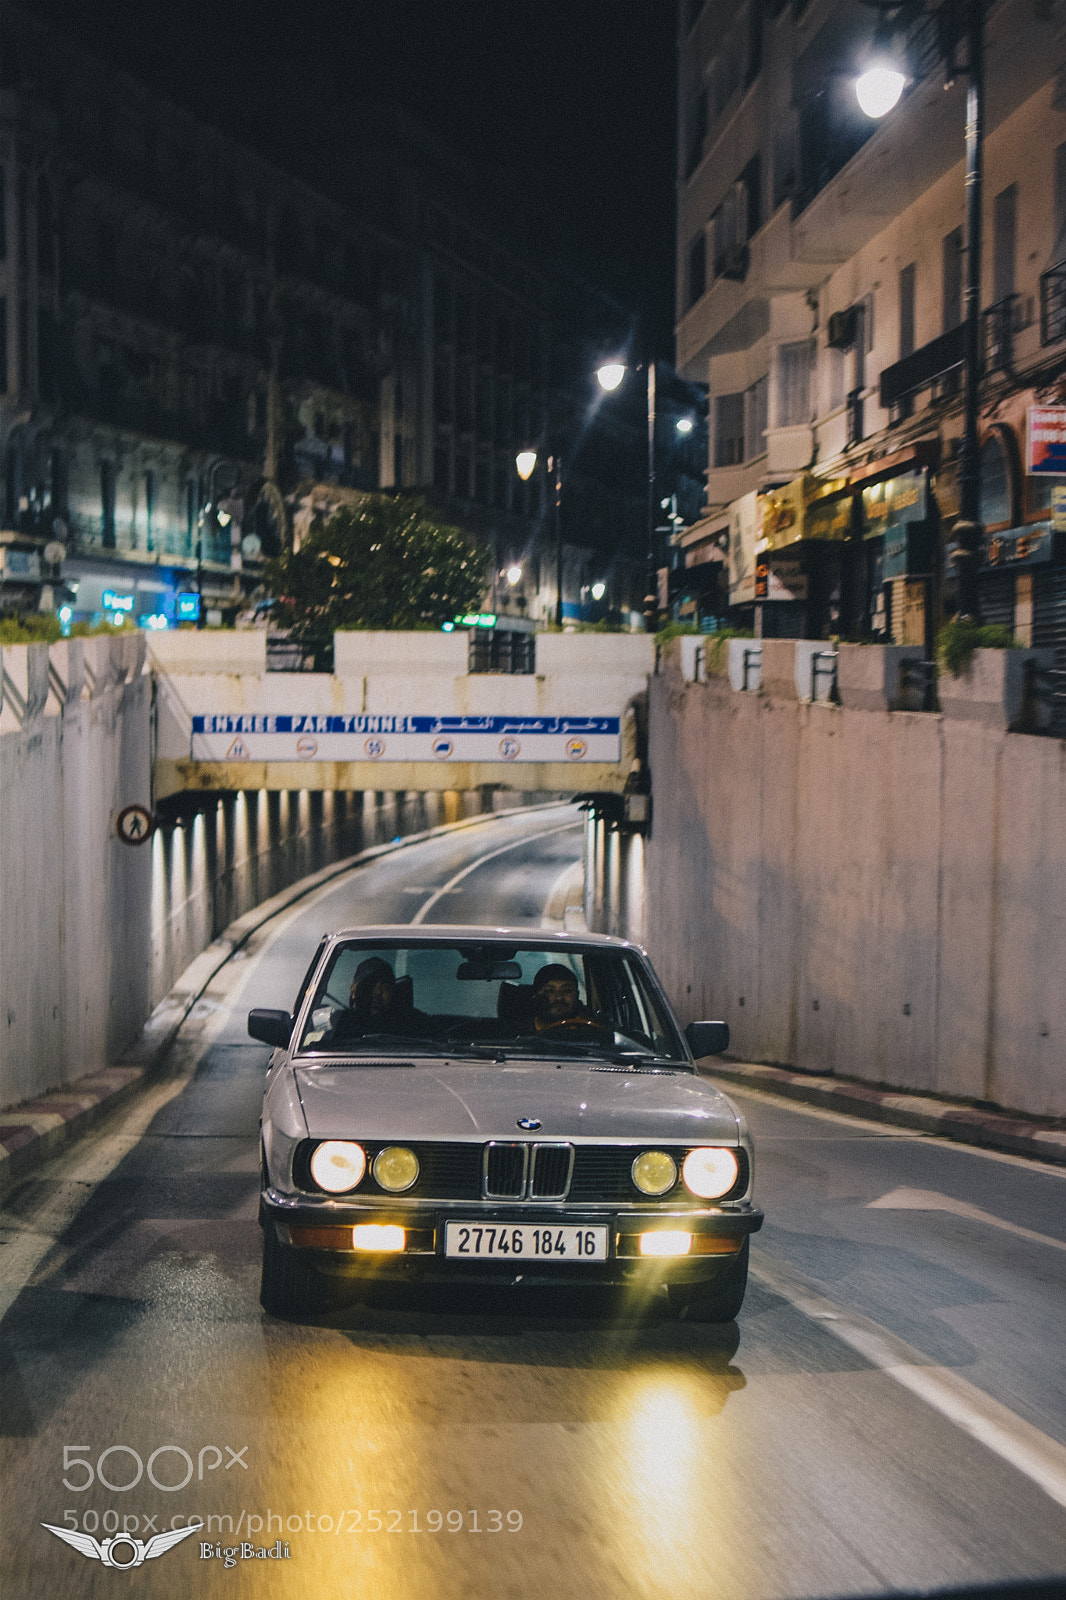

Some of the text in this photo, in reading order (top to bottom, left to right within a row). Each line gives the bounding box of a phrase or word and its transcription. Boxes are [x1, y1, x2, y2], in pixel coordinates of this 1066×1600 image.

[341, 716, 418, 733] TUNNEL
[458, 1228, 596, 1256] 27746 184 16
